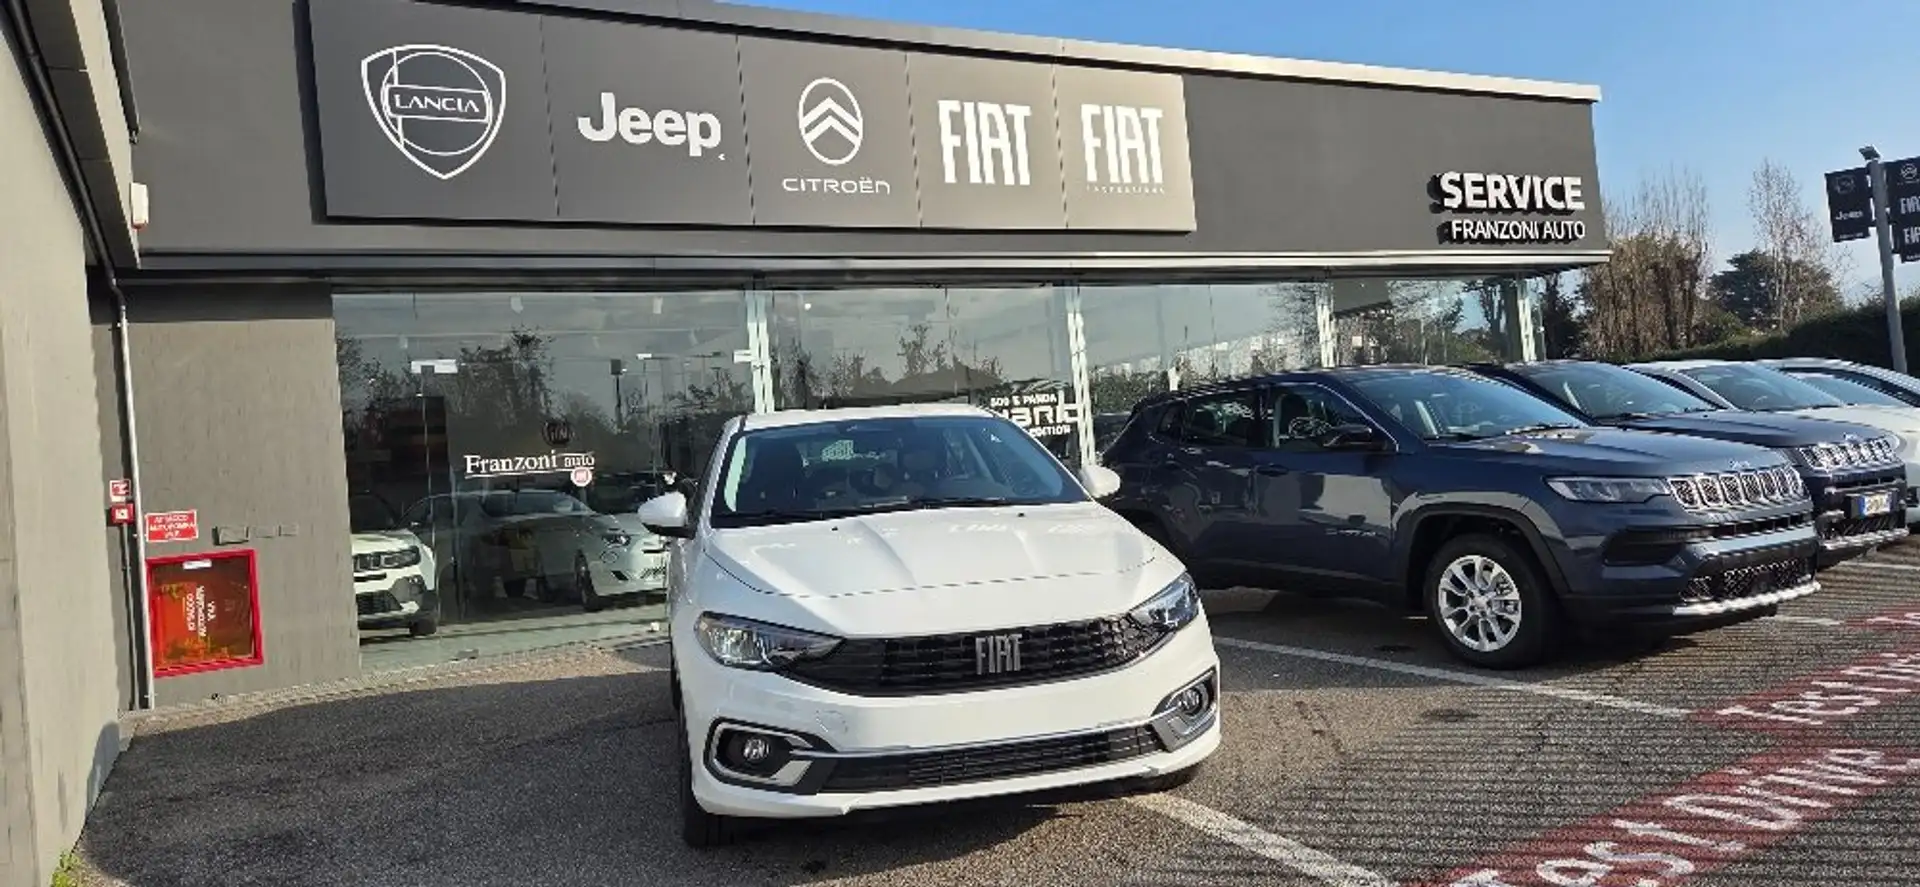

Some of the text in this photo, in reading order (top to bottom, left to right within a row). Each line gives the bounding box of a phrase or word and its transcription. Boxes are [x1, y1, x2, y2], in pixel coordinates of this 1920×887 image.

[393, 94, 480, 113] LANCIA
[577, 91, 722, 158] Jeep
[938, 99, 1032, 186] FIAT
[1080, 103, 1163, 184] FIAT
[1440, 171, 1586, 210] SERVICE
[1452, 219, 1586, 240] FRANZONI AUTO
[463, 449, 557, 475] Franzoni
[975, 633, 1023, 675] FIAT
